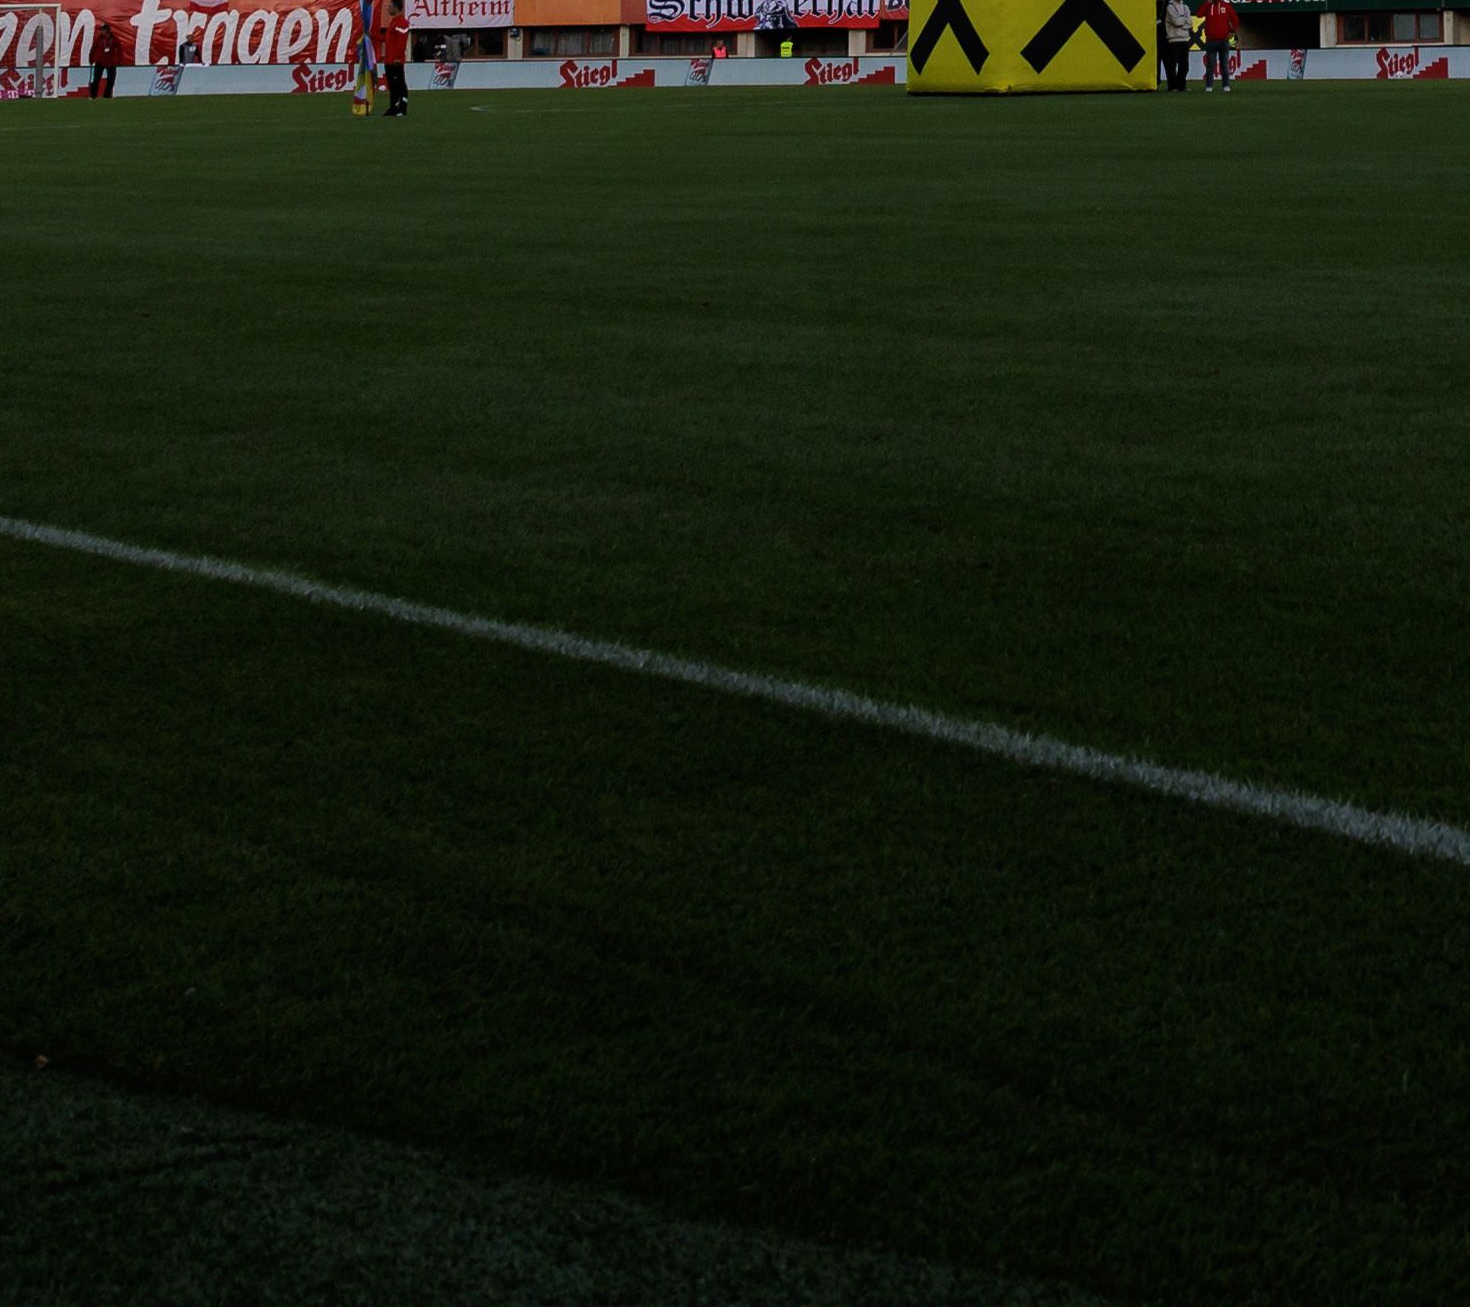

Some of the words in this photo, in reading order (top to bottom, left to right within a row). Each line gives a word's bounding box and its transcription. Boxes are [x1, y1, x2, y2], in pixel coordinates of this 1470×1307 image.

[290, 60, 355, 94] Stiegl
[559, 59, 618, 88] Stiegl
[804, 56, 860, 86] Stiegl
[1376, 45, 1420, 79] Stiegl
